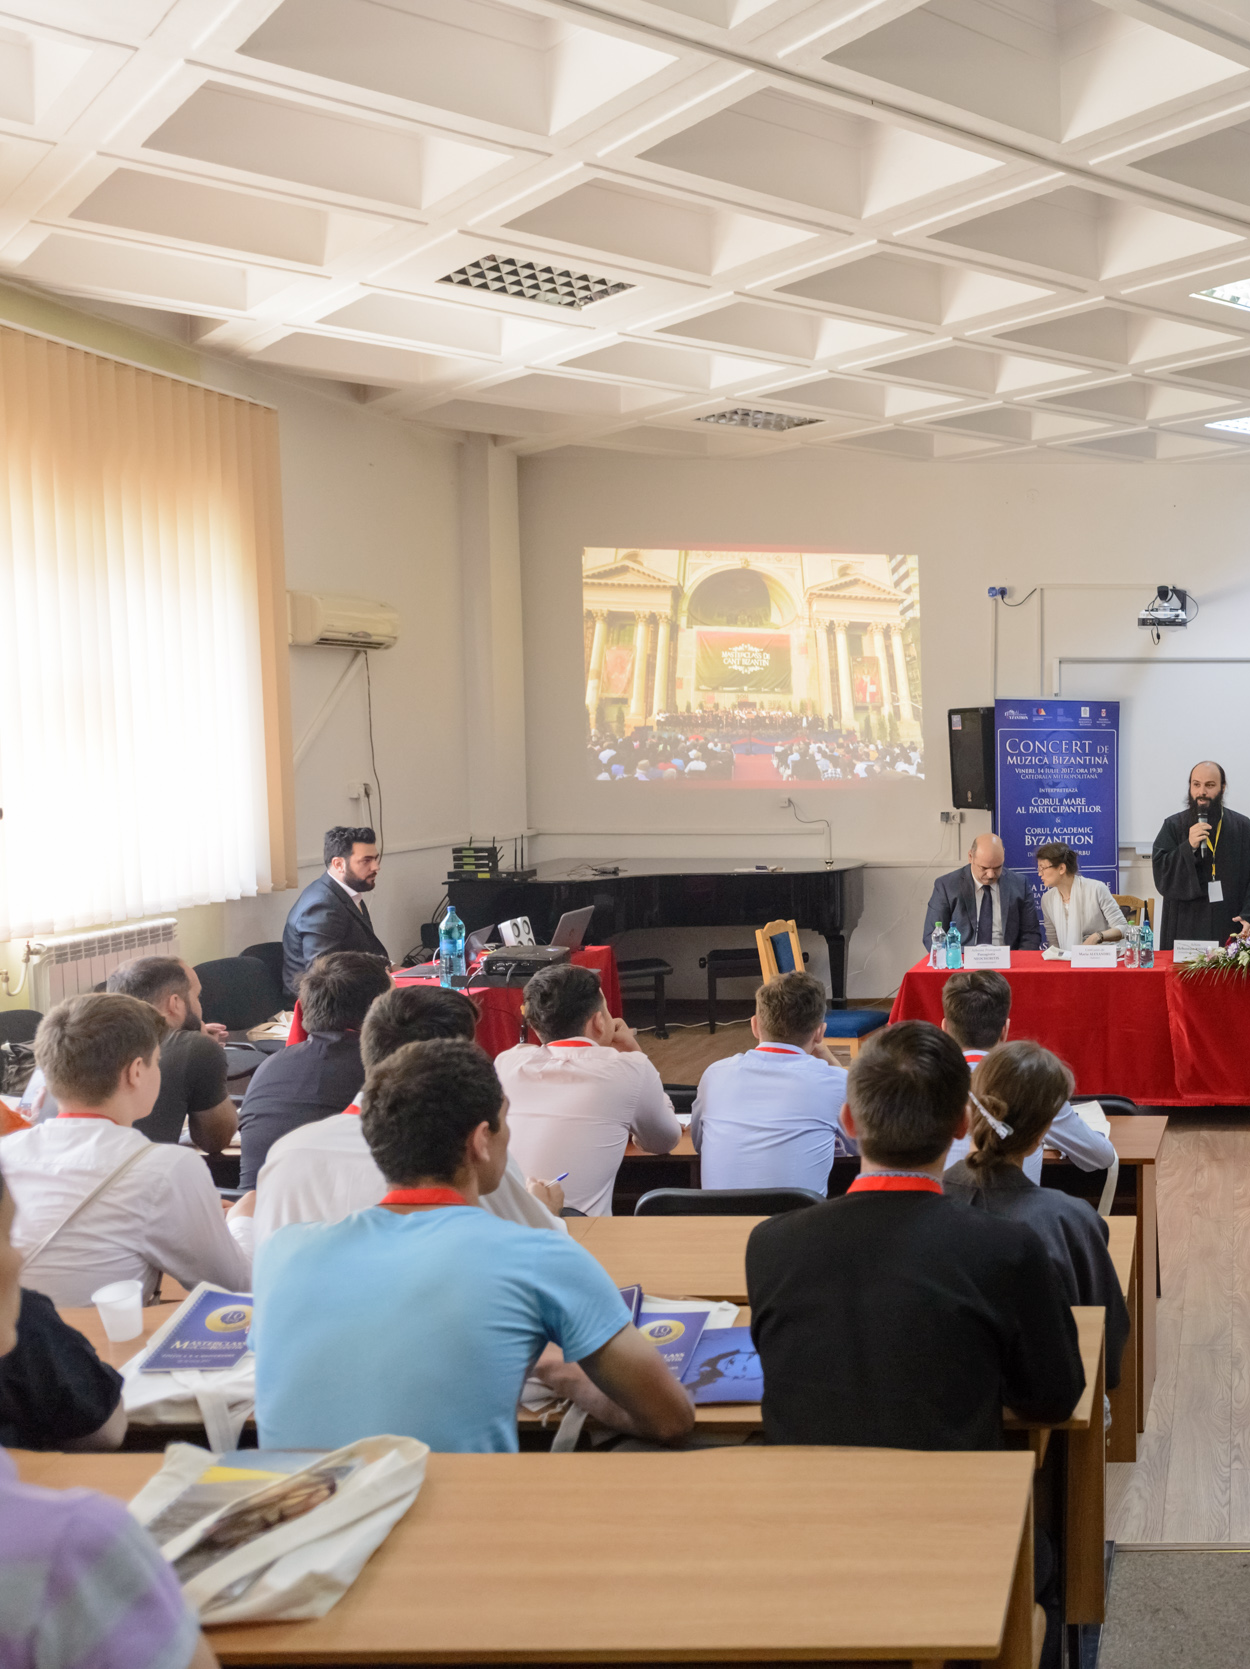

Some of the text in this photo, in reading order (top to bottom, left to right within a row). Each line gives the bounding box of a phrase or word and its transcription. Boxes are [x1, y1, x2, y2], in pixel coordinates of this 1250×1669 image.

[1006, 738, 1109, 753] CONCERT DE
[1006, 754, 1109, 765] MUZICĂ BIZANTINĂ
[1032, 797, 1060, 805] CORUL
[1016, 806, 1026, 814] AL
[1025, 835, 1094, 846] BYZANTION
